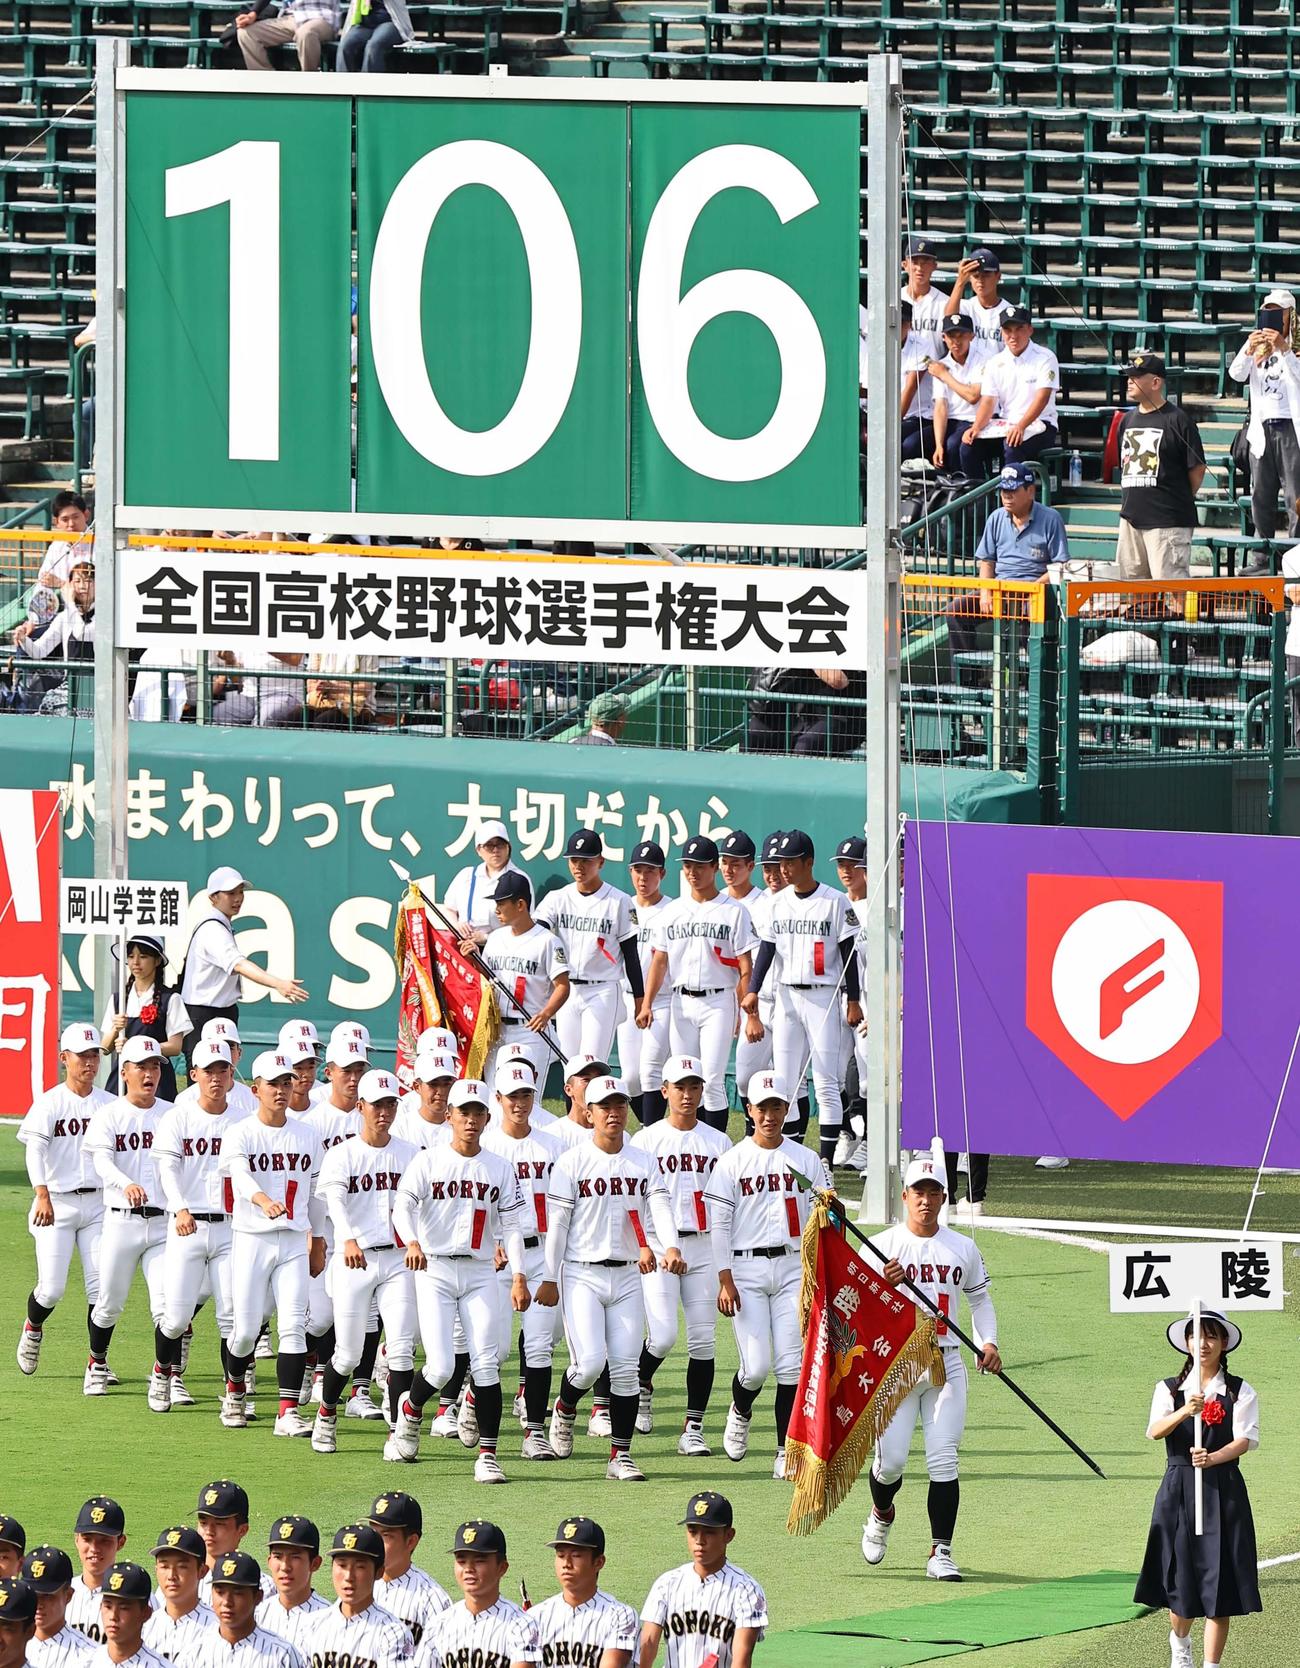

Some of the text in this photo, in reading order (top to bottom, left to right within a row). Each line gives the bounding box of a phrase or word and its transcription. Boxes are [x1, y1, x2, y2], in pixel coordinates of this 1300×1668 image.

[165, 140, 826, 482] 106
[136, 567, 849, 655] 全国高校野球選手権大会
[68, 886, 179, 927] 岡山学芸館
[668, 922, 731, 941] GAKUGEIKAN
[773, 920, 831, 937] GAKUGEIKAN
[54, 1118, 91, 1138] KOR
[115, 1131, 154, 1152] KOR
[183, 1137, 222, 1157] KOR
[249, 1152, 312, 1173] KORYO
[347, 1172, 402, 1194] KORY
[432, 1181, 500, 1203] KORYO
[578, 1177, 649, 1198] KORYO
[905, 1263, 963, 1286] ORYO
[441, 1647, 511, 1668] OHOK
[542, 1641, 605, 1667] OHOK
